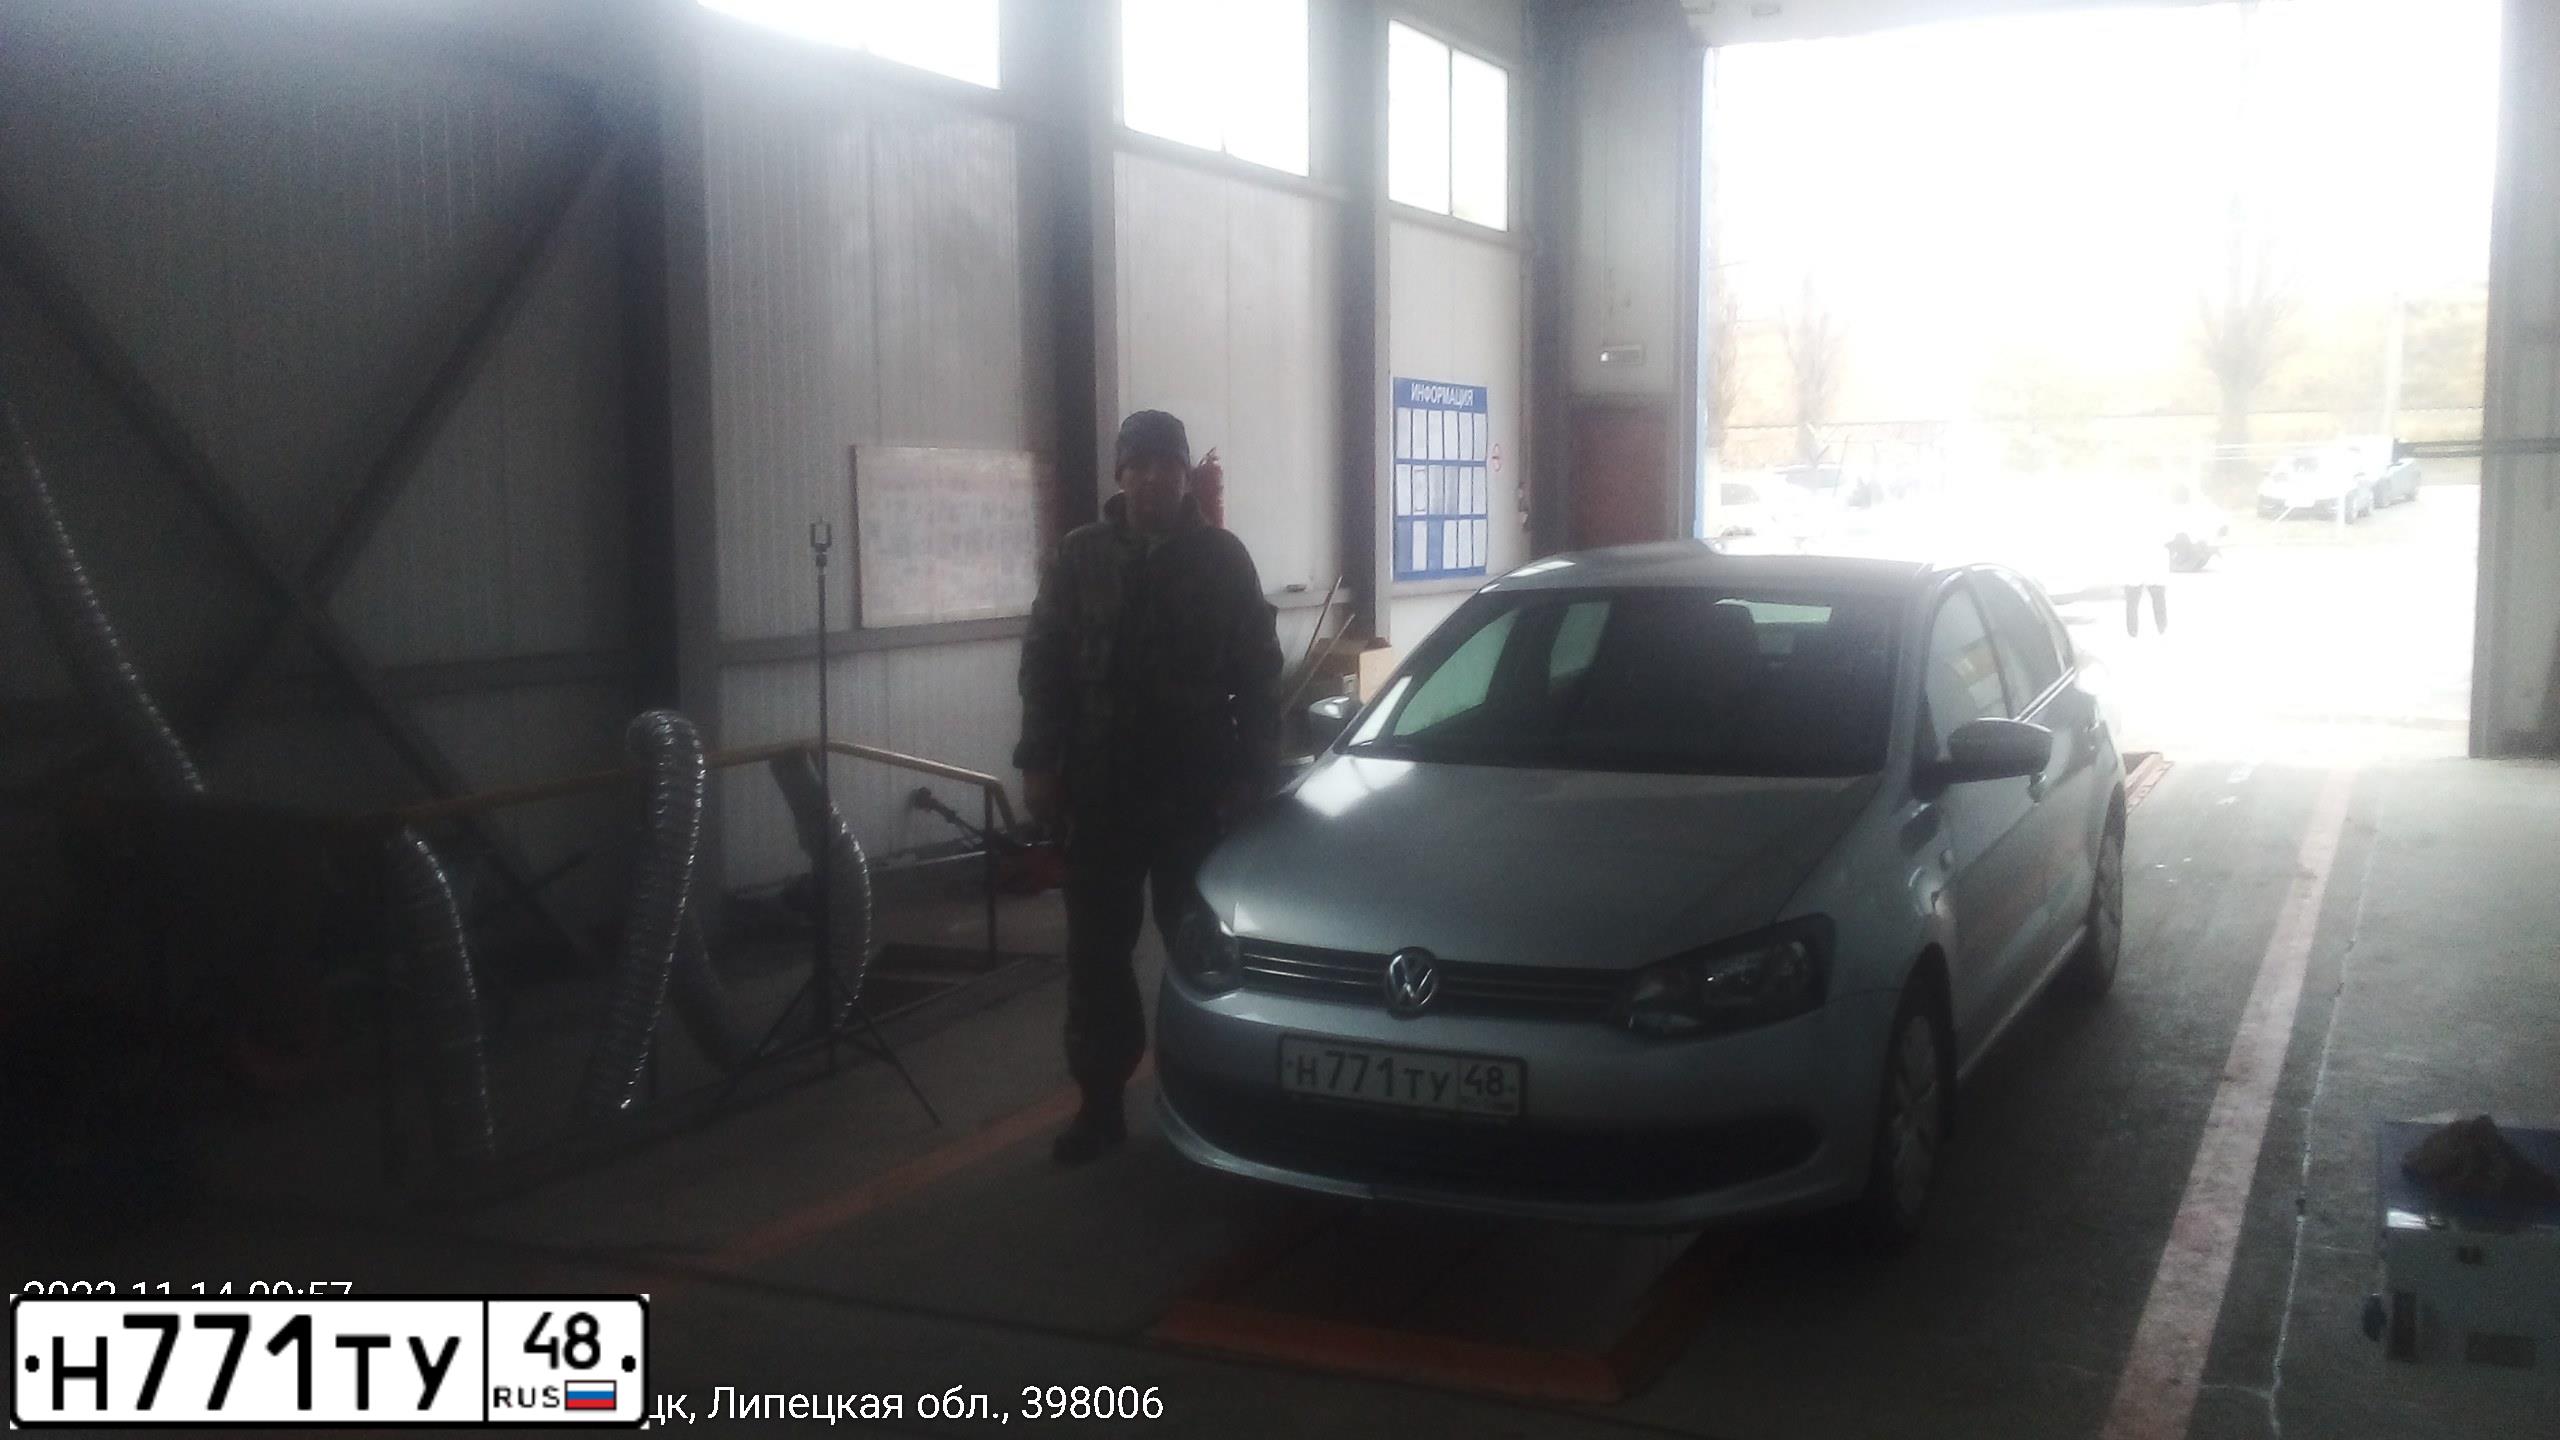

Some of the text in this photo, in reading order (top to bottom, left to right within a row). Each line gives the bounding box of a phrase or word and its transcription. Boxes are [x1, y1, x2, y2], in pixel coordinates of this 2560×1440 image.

[1411, 381, 1474, 408] ИНФОРМАЦИЯ
[1297, 1050, 1505, 1101] Н771ТУ 48
